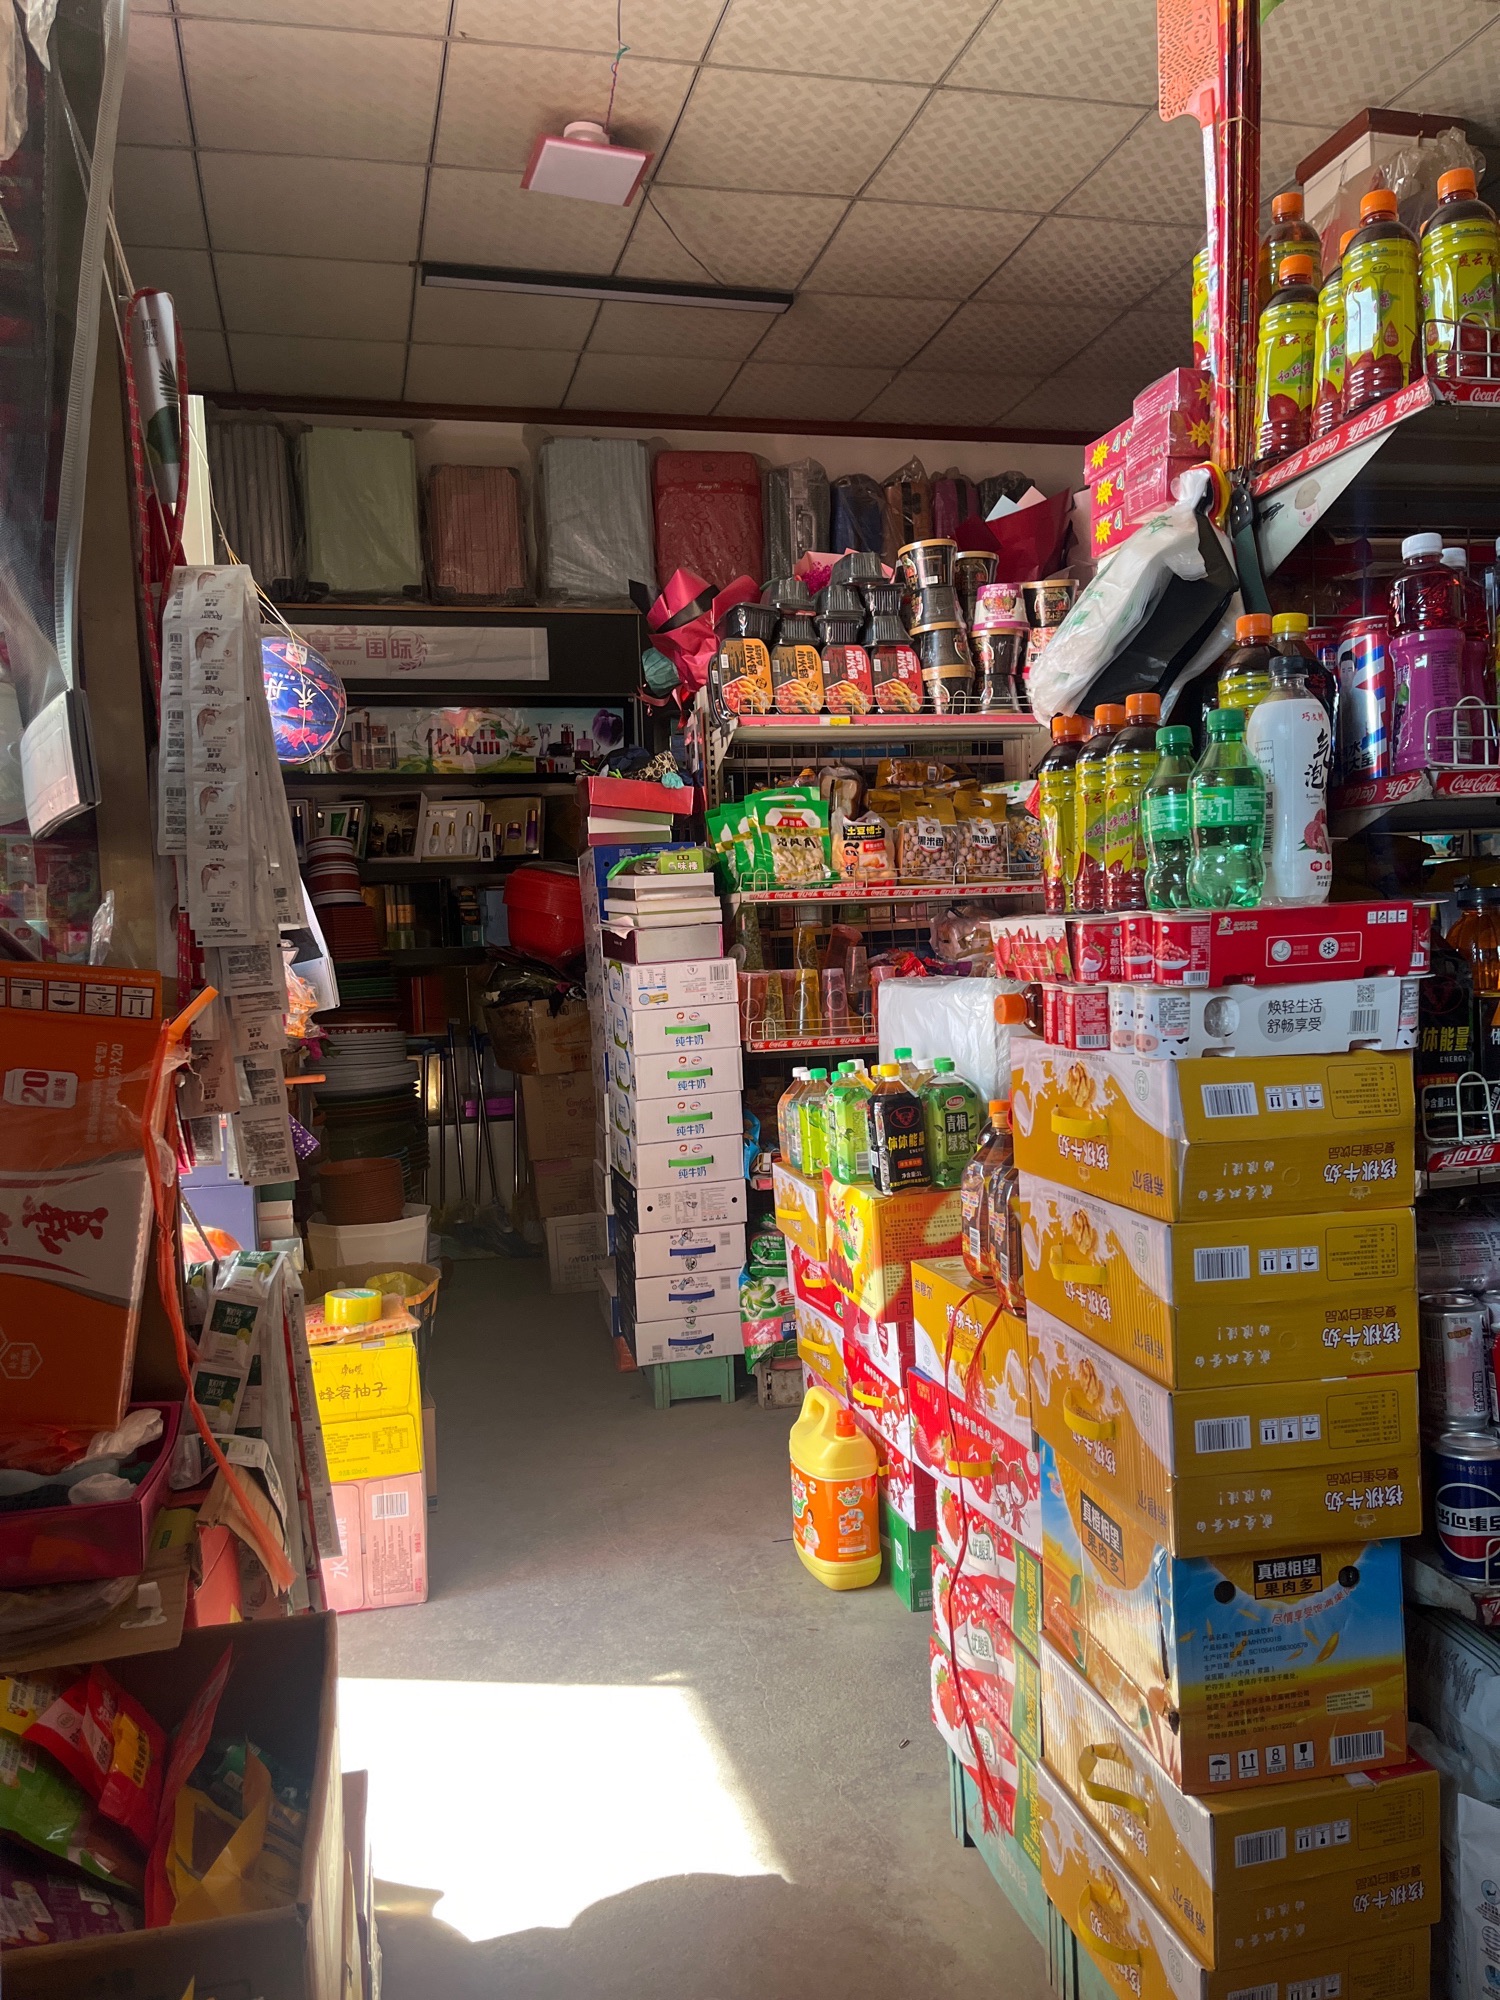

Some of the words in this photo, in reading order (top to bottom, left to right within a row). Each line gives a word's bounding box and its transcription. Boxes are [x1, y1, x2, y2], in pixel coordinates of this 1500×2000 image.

[845, 825, 883, 837] 土豆博士
[917, 834, 946, 847] 黑米香
[971, 833, 999, 846] 黑米香
[1108, 936, 1121, 977] 草莓酸奶
[1267, 997, 1323, 1016] 焕轻生活
[1267, 1016, 1322, 1034] 舒畅享受
[675, 1034, 704, 1047] 纯牛奶
[1421, 1026, 1471, 1052] 体能量
[1439, 1054, 1468, 1064] ENERGY
[21, 1070, 50, 1105] 20
[677, 1078, 707, 1091] 纯牛奶
[676, 1123, 705, 1136] 纯牛奶
[945, 1113, 967, 1133] 青梅
[1057, 1135, 1110, 1173] 核桃牛奶
[1328, 1140, 1396, 1160] 复合蛋白饮品
[678, 1165, 708, 1179] 纯牛奶
[1323, 1157, 1399, 1185] 核桃牛奶
[1132, 1168, 1164, 1196] 希穆尔
[1324, 1304, 1398, 1323] 复合蛋白饮品
[1322, 1322, 1401, 1349] 核桃牛奶
[318, 1381, 388, 1403] 蜂蜜柚子
[1326, 1467, 1400, 1487] 复合蛋白饮品
[1324, 1484, 1404, 1513] 核桃牛奶
[1081, 1498, 1120, 1554] 真橙相望
[1087, 1532, 1119, 1578] 果肉多
[1257, 1558, 1318, 1581] 真橙相望
[1264, 1578, 1316, 1596] 果肉多
[1352, 1880, 1426, 1914] 核桃牛奶
